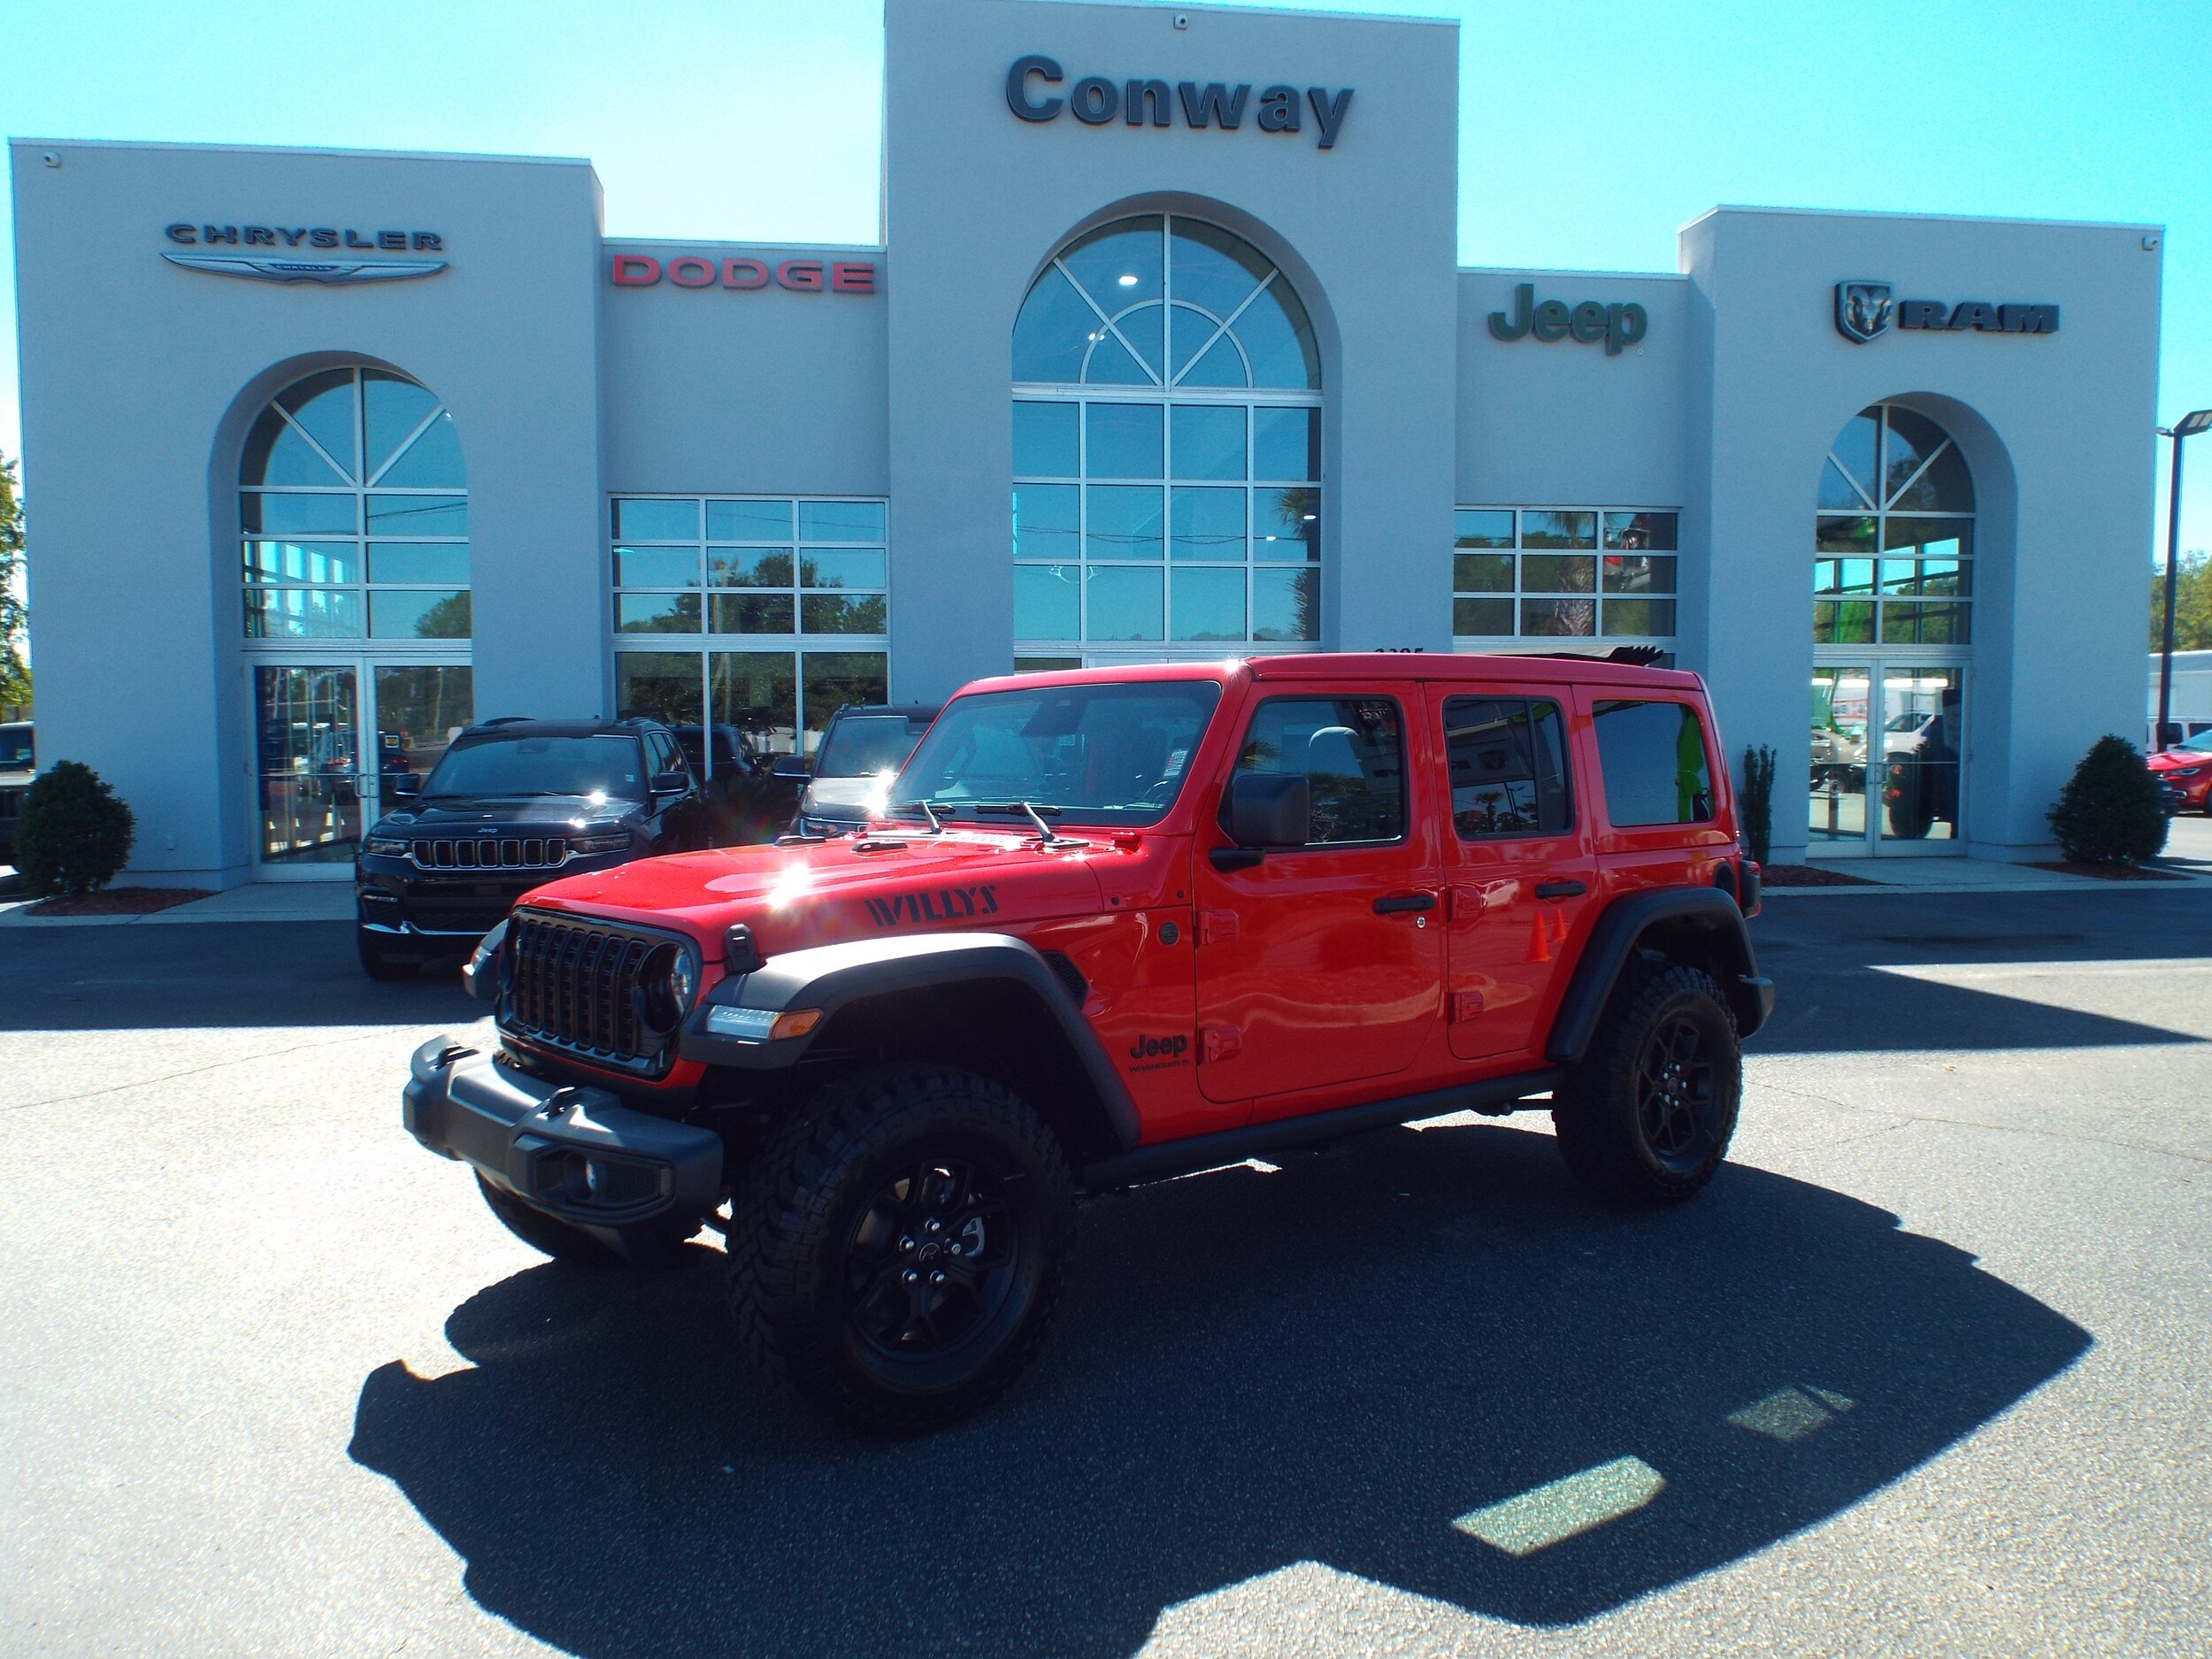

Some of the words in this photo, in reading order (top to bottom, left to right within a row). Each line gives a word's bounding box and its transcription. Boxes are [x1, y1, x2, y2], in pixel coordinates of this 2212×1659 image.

[1007, 55, 1354, 149] Conway
[165, 224, 442, 250] CHRYSLER
[612, 255, 874, 293] DODGE
[1487, 283, 1647, 356] Jeep
[1898, 300, 2060, 334] RAM
[864, 885, 999, 927] WILLYS
[1130, 1034, 1187, 1059] Jeep
